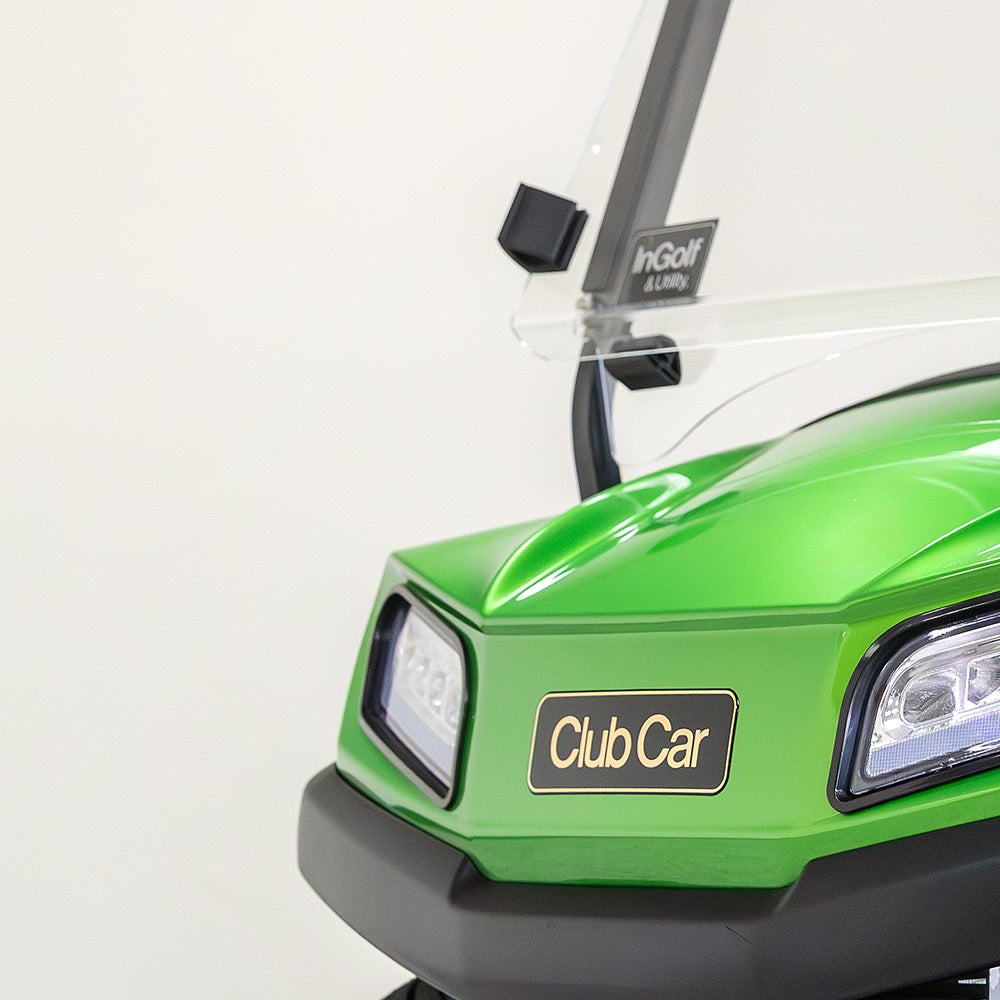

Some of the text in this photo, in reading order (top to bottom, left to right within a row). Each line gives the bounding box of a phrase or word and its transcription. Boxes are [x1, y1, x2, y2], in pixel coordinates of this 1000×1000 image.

[632, 237, 705, 274] InGolf
[550, 713, 710, 769] Club Car
